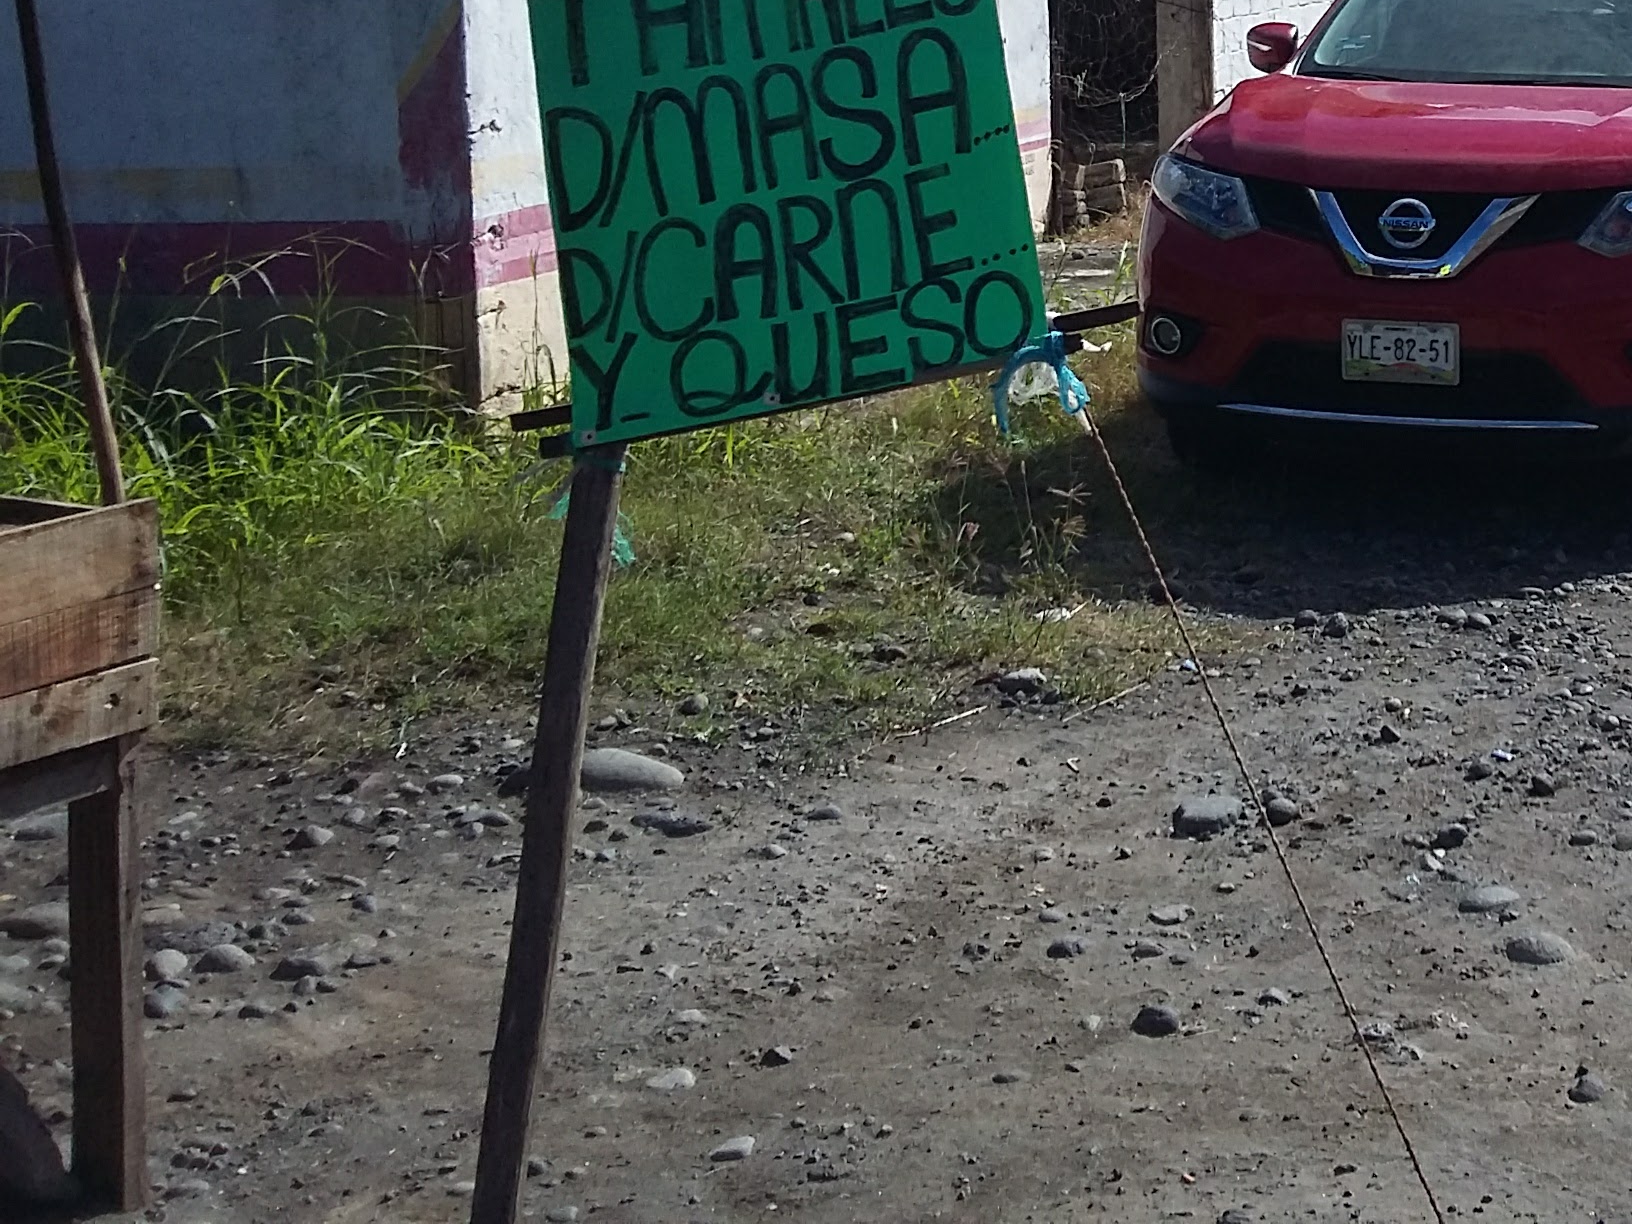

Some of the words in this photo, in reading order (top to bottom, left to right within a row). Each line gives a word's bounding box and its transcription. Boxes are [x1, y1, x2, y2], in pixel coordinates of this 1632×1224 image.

[1383, 219, 1429, 229] NISSAN
[670, 270, 1034, 417] QUESO
[1347, 334, 1449, 364] YLE-82-51
